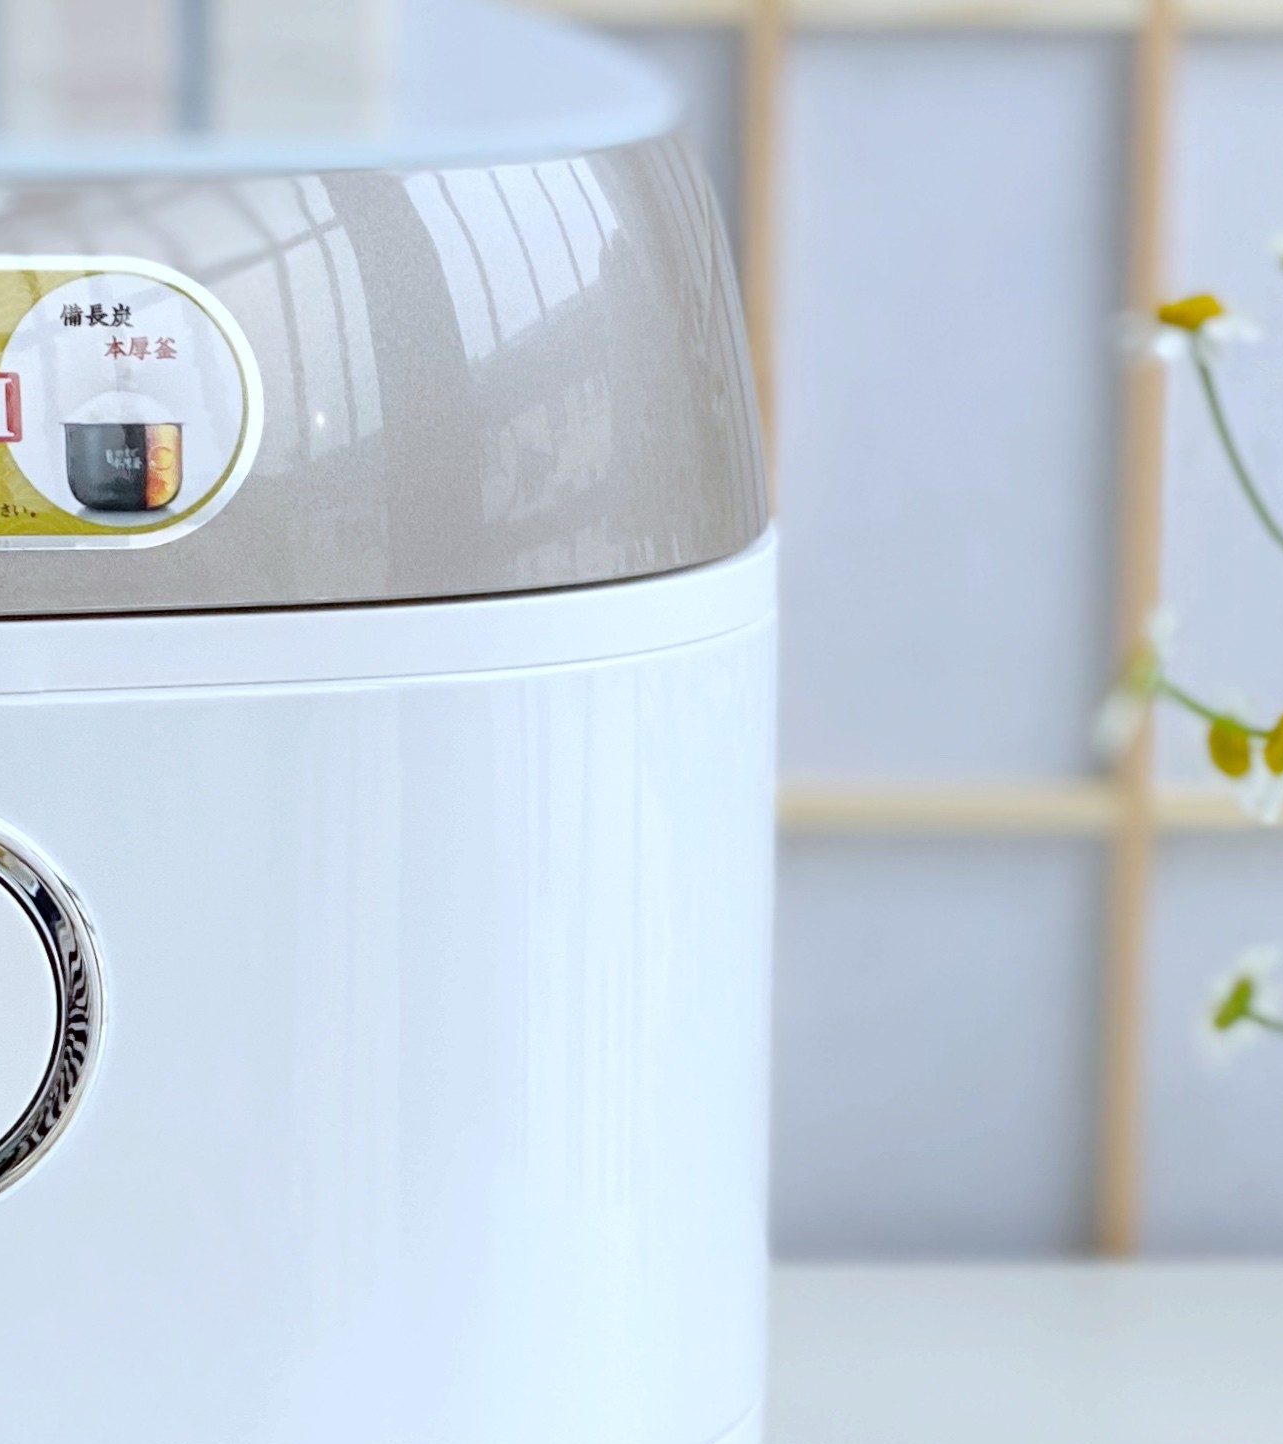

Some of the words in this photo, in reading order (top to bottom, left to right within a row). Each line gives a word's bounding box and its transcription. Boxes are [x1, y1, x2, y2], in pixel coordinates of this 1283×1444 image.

[60, 303, 134, 328] 備長炭
[104, 335, 178, 360] 本厚釜
